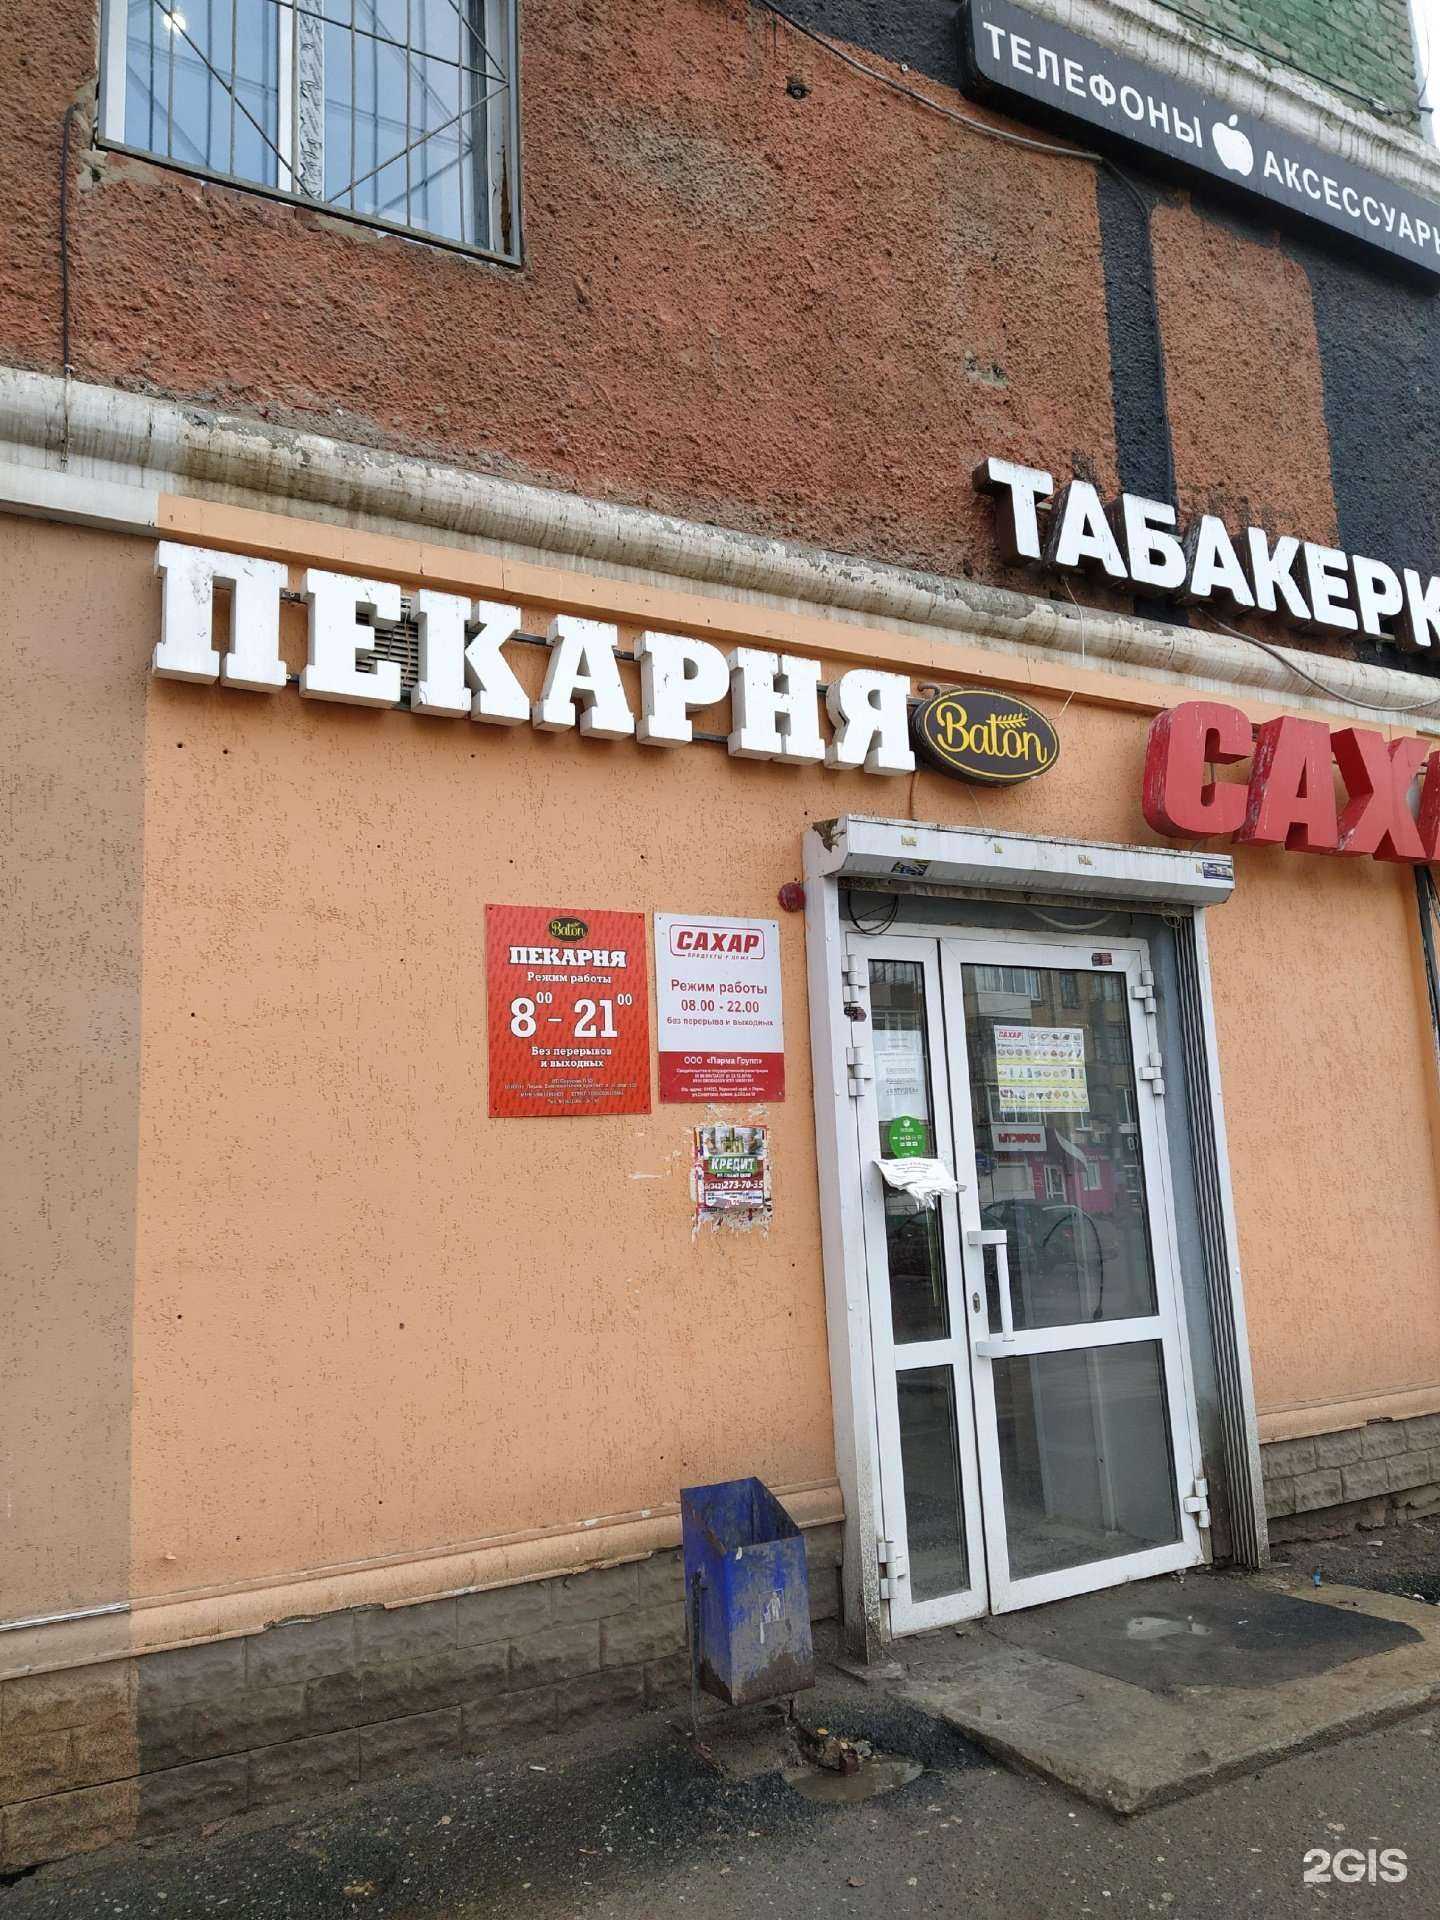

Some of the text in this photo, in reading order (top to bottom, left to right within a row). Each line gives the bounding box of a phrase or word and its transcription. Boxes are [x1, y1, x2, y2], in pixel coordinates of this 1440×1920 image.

[982, 21, 1203, 149] ТЕЛЕФОНЫ
[984, 456, 1440, 648] ТАБАКЕРК
[153, 540, 916, 776] ПЕКАРНЯ
[936, 701, 1048, 764] Baton
[1145, 701, 1440, 863] САХ
[551, 920, 586, 937] Baton
[676, 930, 760, 954] САХАР
[509, 945, 627, 968] ПЕКАРНЯ
[527, 972, 612, 984] Режим работы
[671, 979, 768, 995] Режим работы
[681, 999, 715, 1012] 08.00
[727, 1000, 760, 1013] 22.00
[683, 1017, 723, 1027] перерыва
[725, 1018, 731, 1026] и
[732, 1018, 774, 1028] выходных
[531, 1046, 612, 1057] Без перерывов
[540, 1060, 605, 1069] и выходных
[684, 1056, 703, 1064] ООО
[711, 1157, 755, 1172] КРЕДИТ
